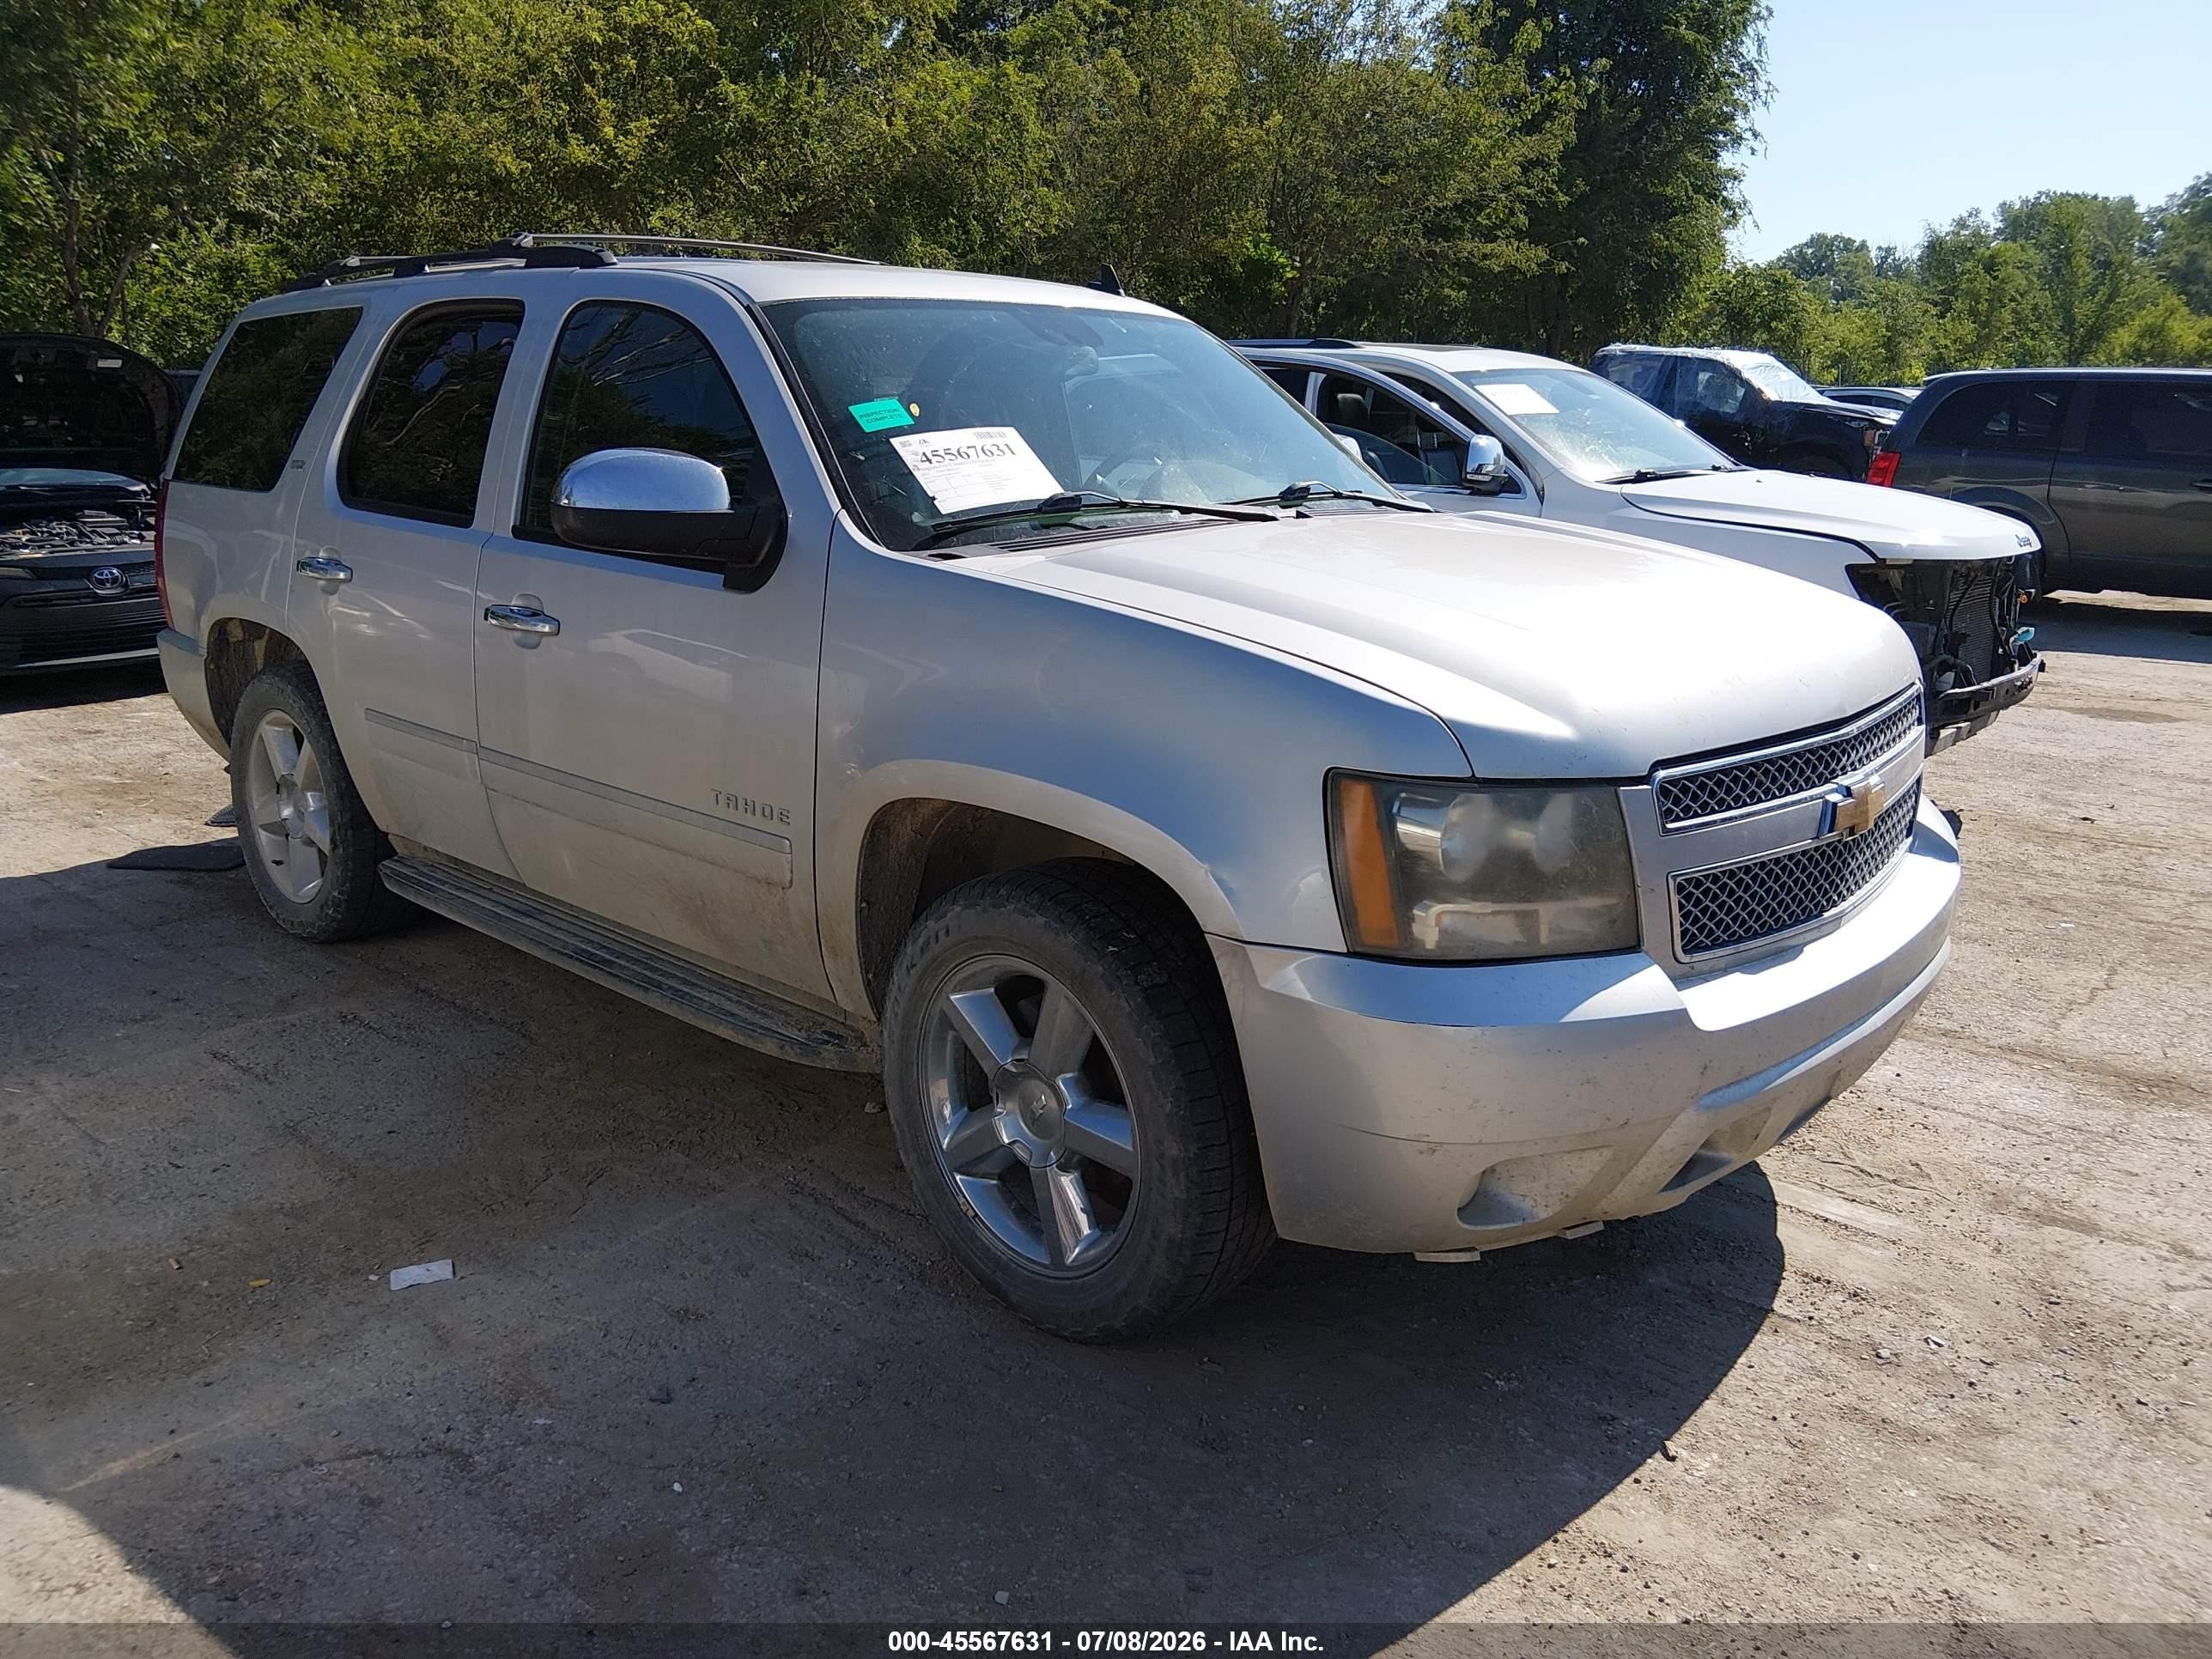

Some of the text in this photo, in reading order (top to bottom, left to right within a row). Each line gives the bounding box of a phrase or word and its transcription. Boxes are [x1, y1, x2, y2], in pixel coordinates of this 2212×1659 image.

[859, 408, 900, 419] INSPECTION
[866, 413, 903, 424] COMPLETE
[920, 443, 1018, 465] 45567631
[711, 788, 792, 826] TAHOE
